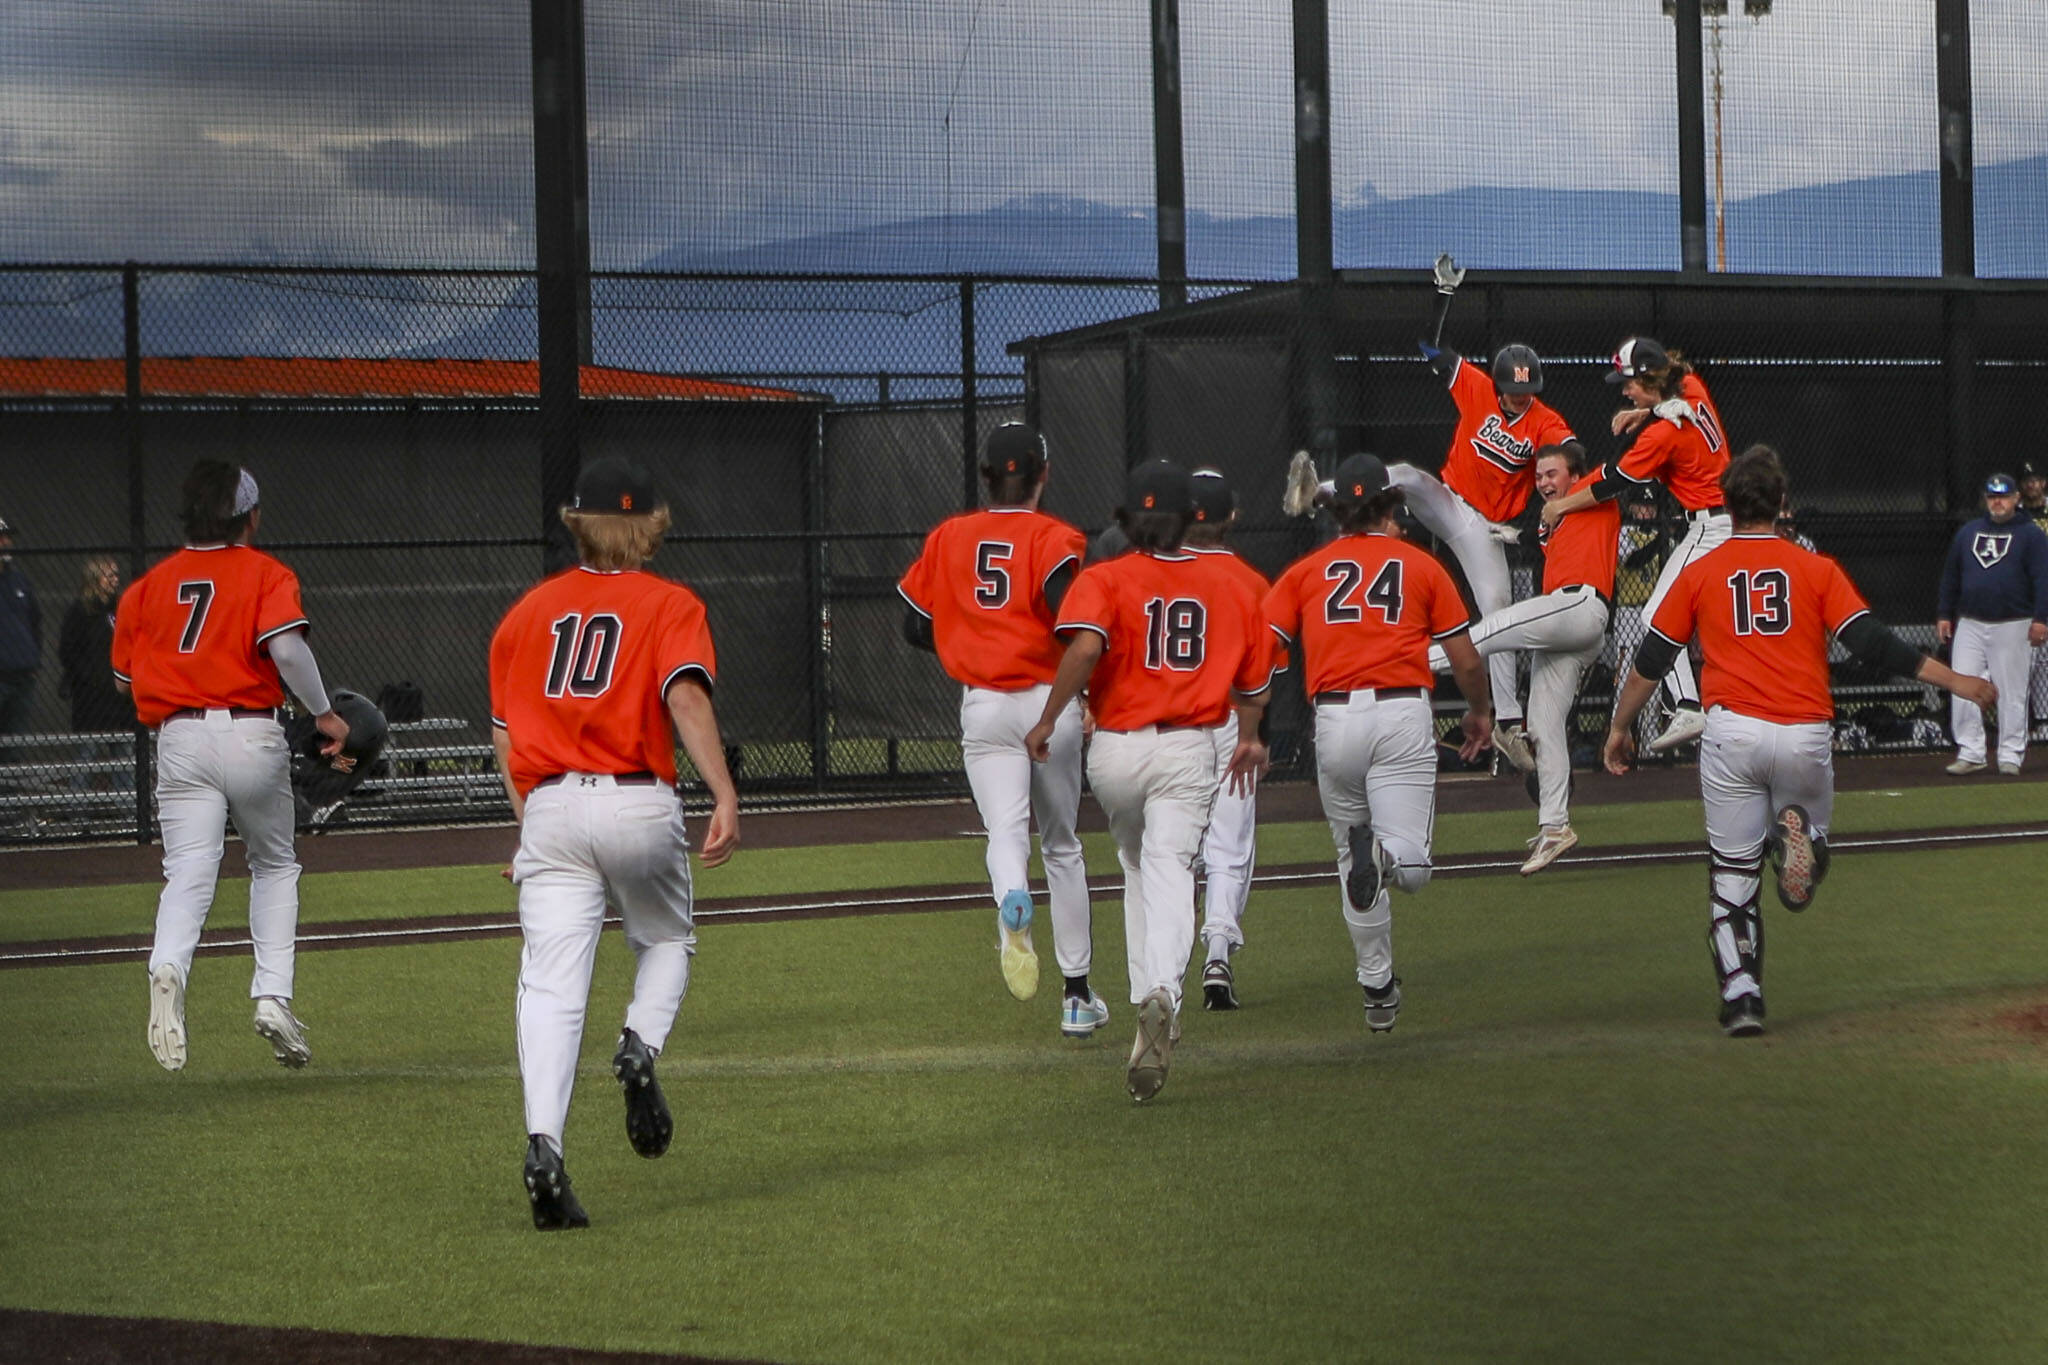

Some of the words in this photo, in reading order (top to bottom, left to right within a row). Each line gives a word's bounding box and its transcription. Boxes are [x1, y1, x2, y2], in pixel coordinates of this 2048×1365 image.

[1514, 367, 1530, 383] M
[1696, 401, 1722, 453] 11
[975, 541, 1014, 609] 5
[1980, 538, 1999, 558] A
[178, 580, 215, 653] 7
[1325, 559, 1403, 625] 24
[1728, 569, 1792, 637] 13
[544, 612, 623, 698] 10
[1144, 597, 1206, 671] 18
